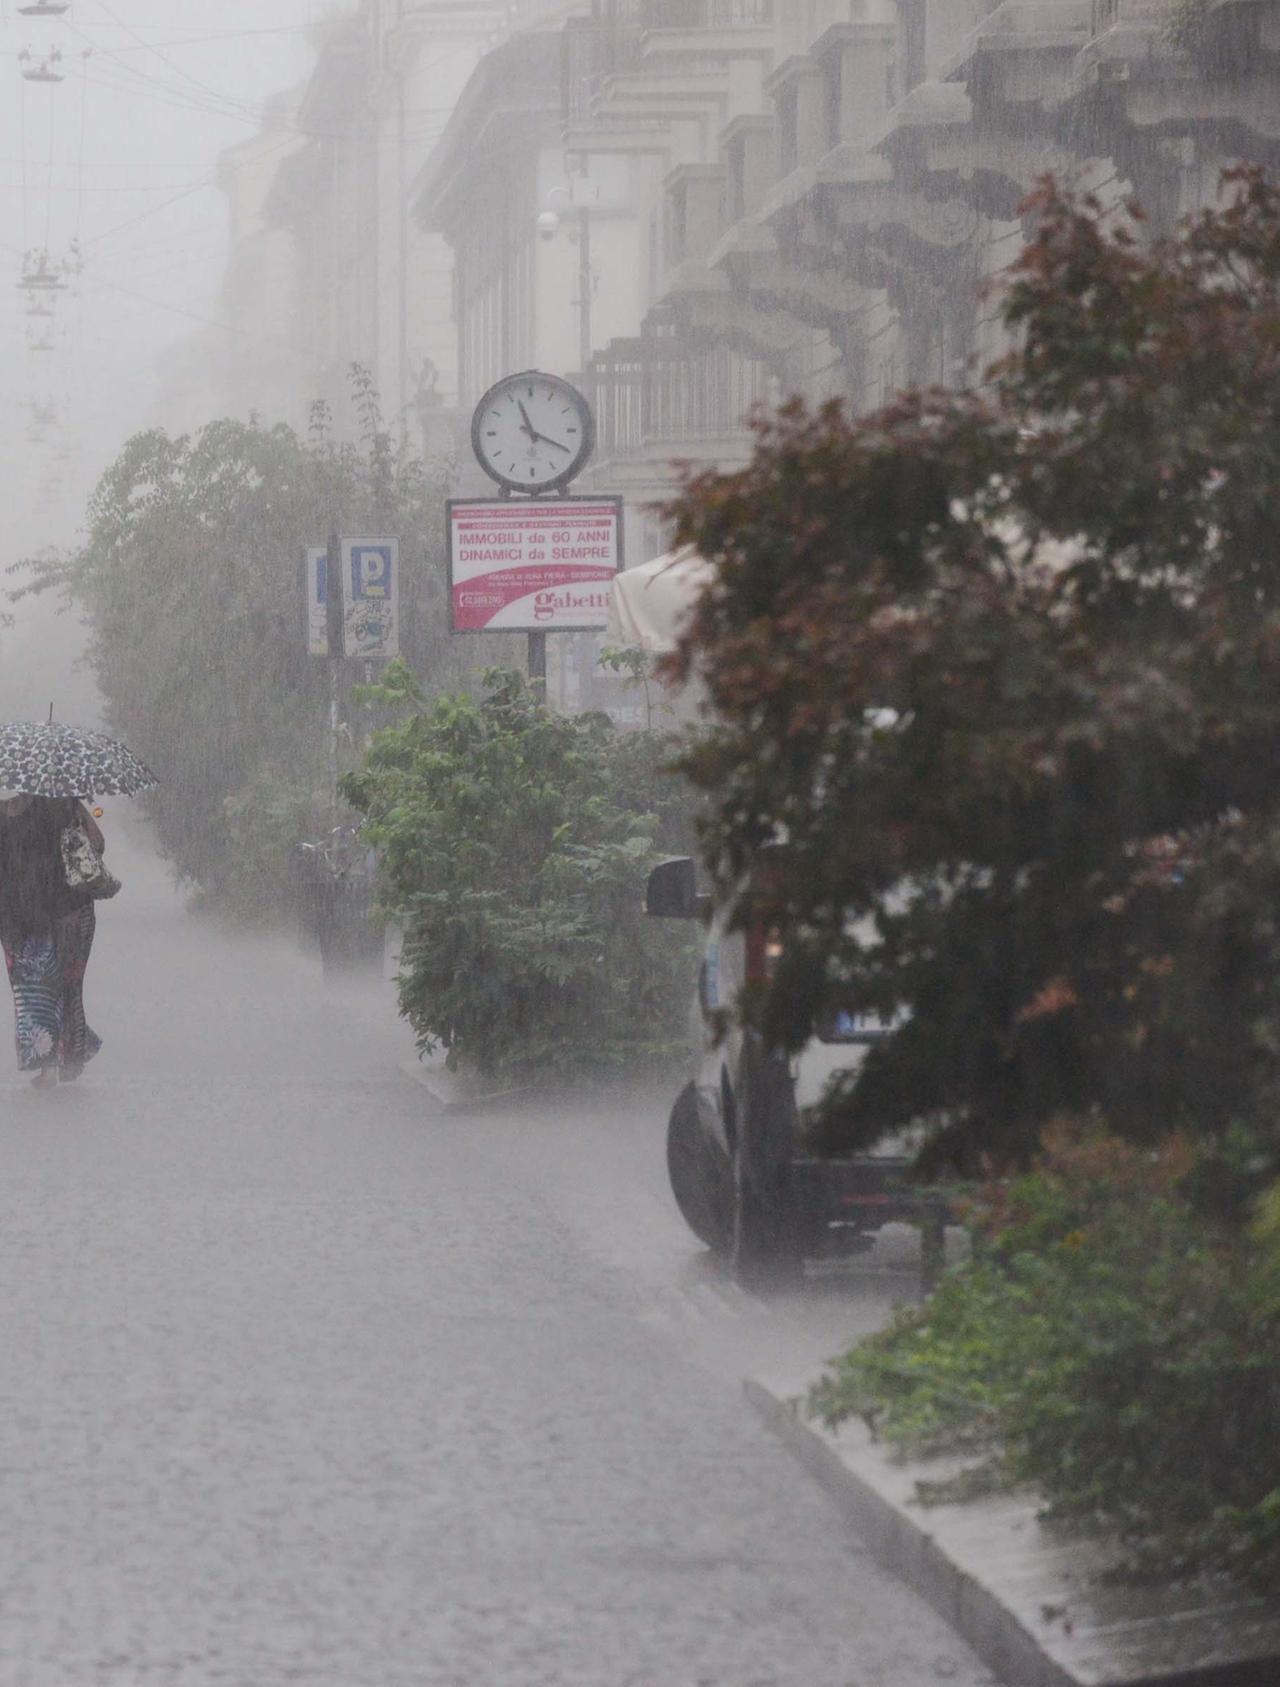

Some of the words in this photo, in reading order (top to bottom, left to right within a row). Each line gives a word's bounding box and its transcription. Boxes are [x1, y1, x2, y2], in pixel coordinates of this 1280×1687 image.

[459, 532, 522, 545] IMMOBILI
[528, 533, 545, 543] da
[552, 531, 570, 543] 60
[577, 530, 610, 542] ANNI
[459, 548, 522, 561] DINAMICI
[528, 548, 545, 560] da
[552, 547, 610, 559] SEMPRE
[533, 591, 610, 621] gabetti
